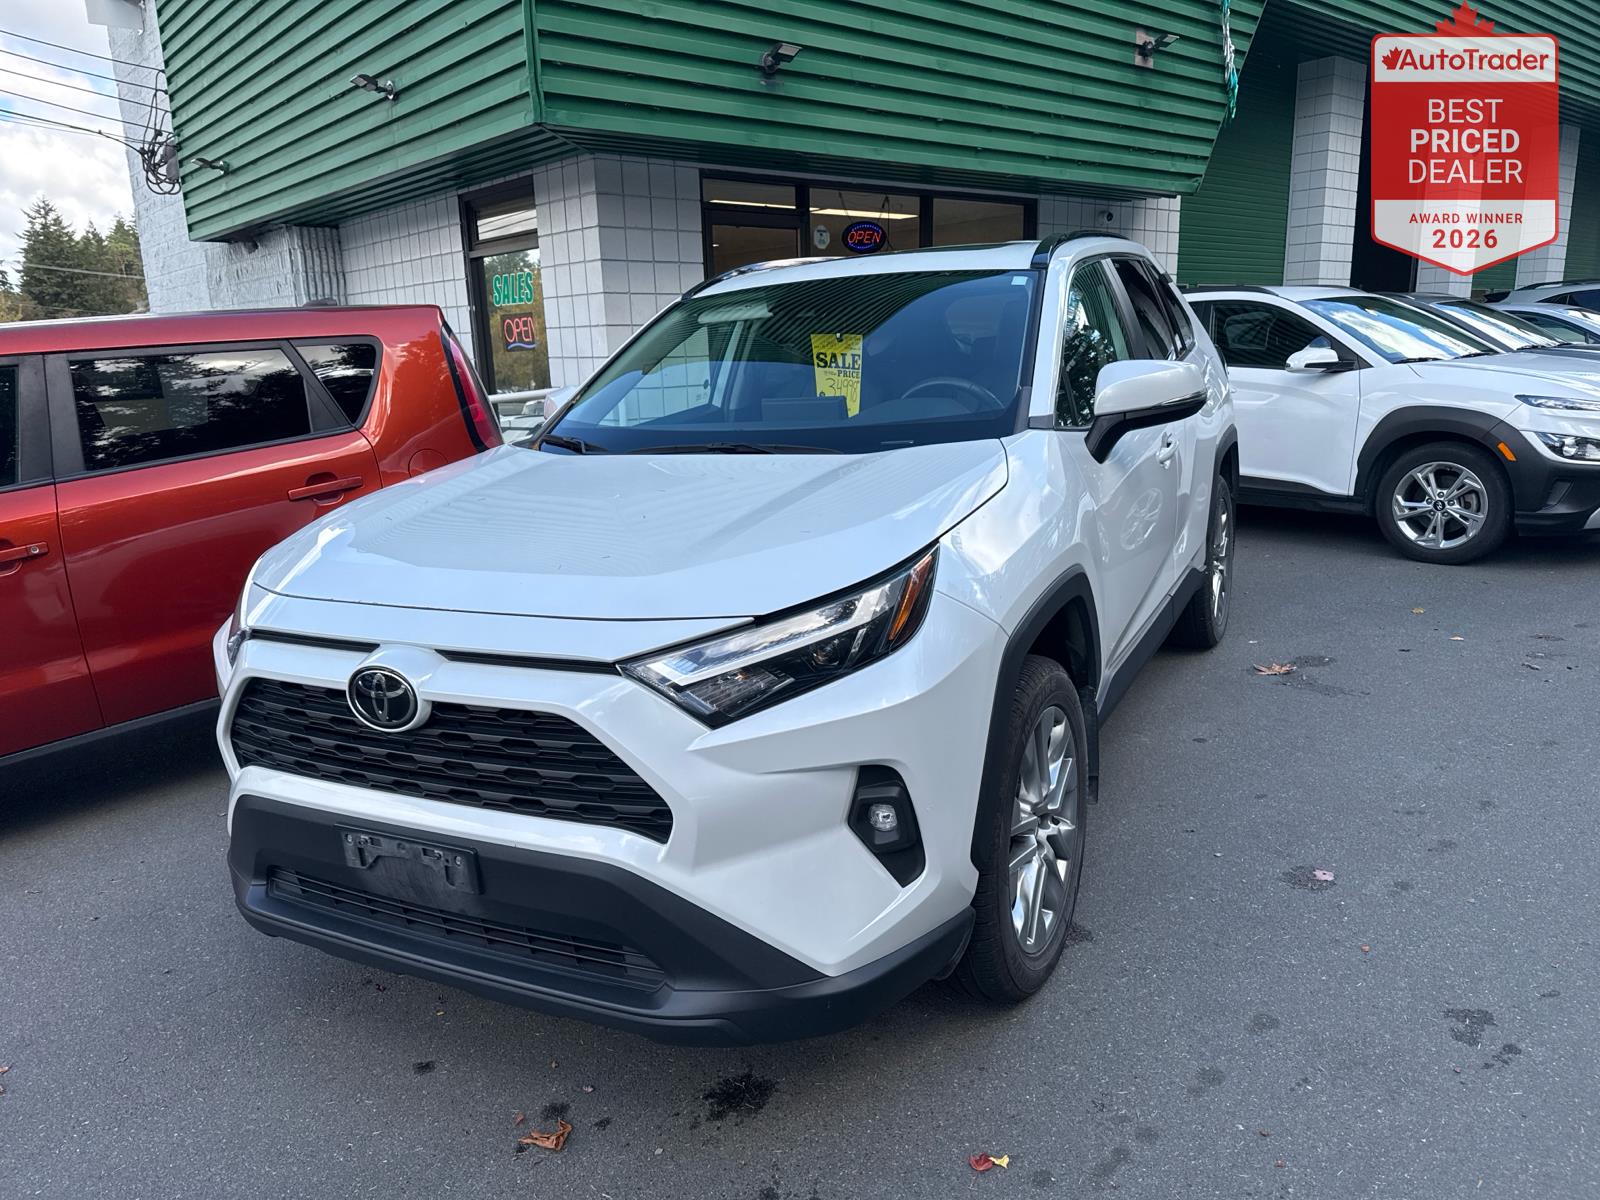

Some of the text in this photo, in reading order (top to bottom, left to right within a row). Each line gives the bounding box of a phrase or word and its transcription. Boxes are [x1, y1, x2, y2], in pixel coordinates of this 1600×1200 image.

[847, 230, 882, 244] OPEN
[492, 271, 534, 306] SALES
[504, 317, 536, 343] OPEN
[815, 352, 861, 370] SALE
[837, 370, 860, 379] PRICE
